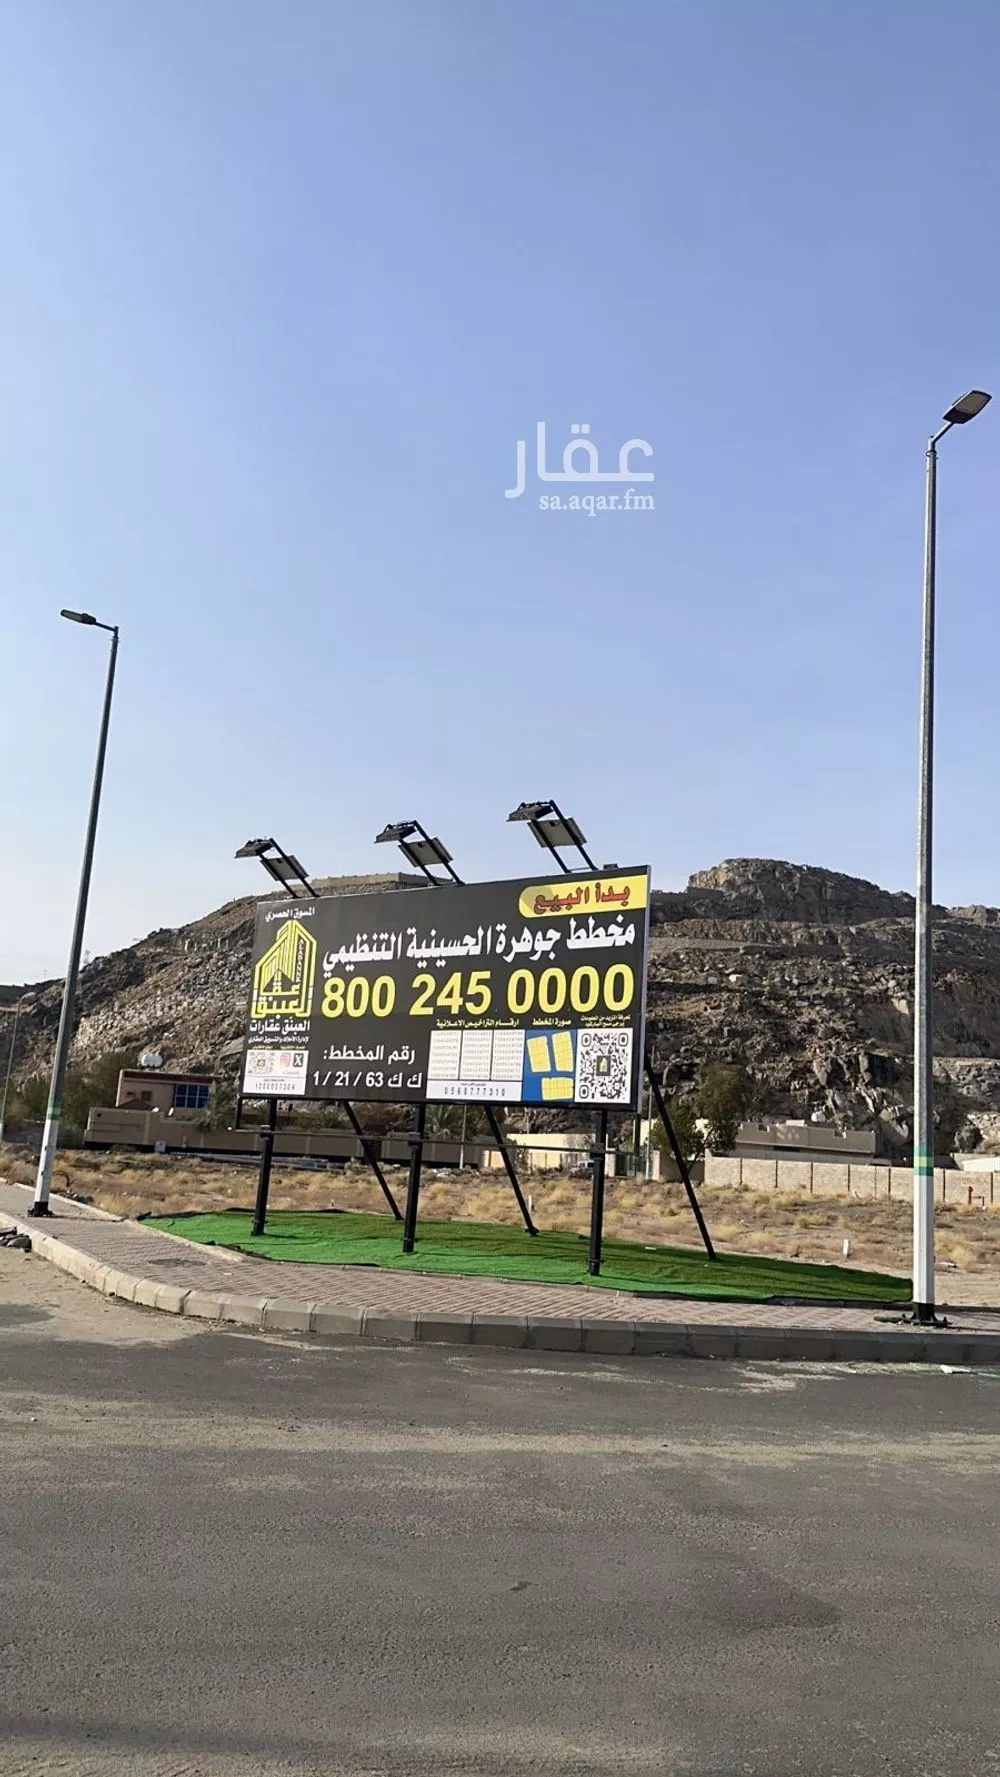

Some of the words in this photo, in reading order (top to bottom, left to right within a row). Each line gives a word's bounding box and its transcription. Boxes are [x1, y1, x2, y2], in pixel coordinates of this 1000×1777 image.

[533, 886, 590, 914] البيع
[595, 882, 631, 907] بدأ
[294, 907, 315, 919] المسوق
[566, 914, 636, 950] مخطط
[406, 925, 491, 969] الحسينية
[495, 922, 562, 963] جوهرة
[323, 932, 402, 978] التنظيمي
[321, 975, 396, 1018] 800
[409, 970, 492, 1016] 245
[507, 963, 635, 1014] 0000
[249, 1018, 281, 1035] عقارات
[532, 1017, 554, 1026] المخطط
[555, 1017, 572, 1027] صورة
[323, 1044, 384, 1061] المخطط:
[388, 1045, 415, 1065] رقم
[313, 1070, 320, 1086] 1
[335, 1071, 349, 1086] 21
[365, 1071, 383, 1087] 63
[388, 1072, 403, 1088] ك
[406, 1072, 422, 1088] ك
